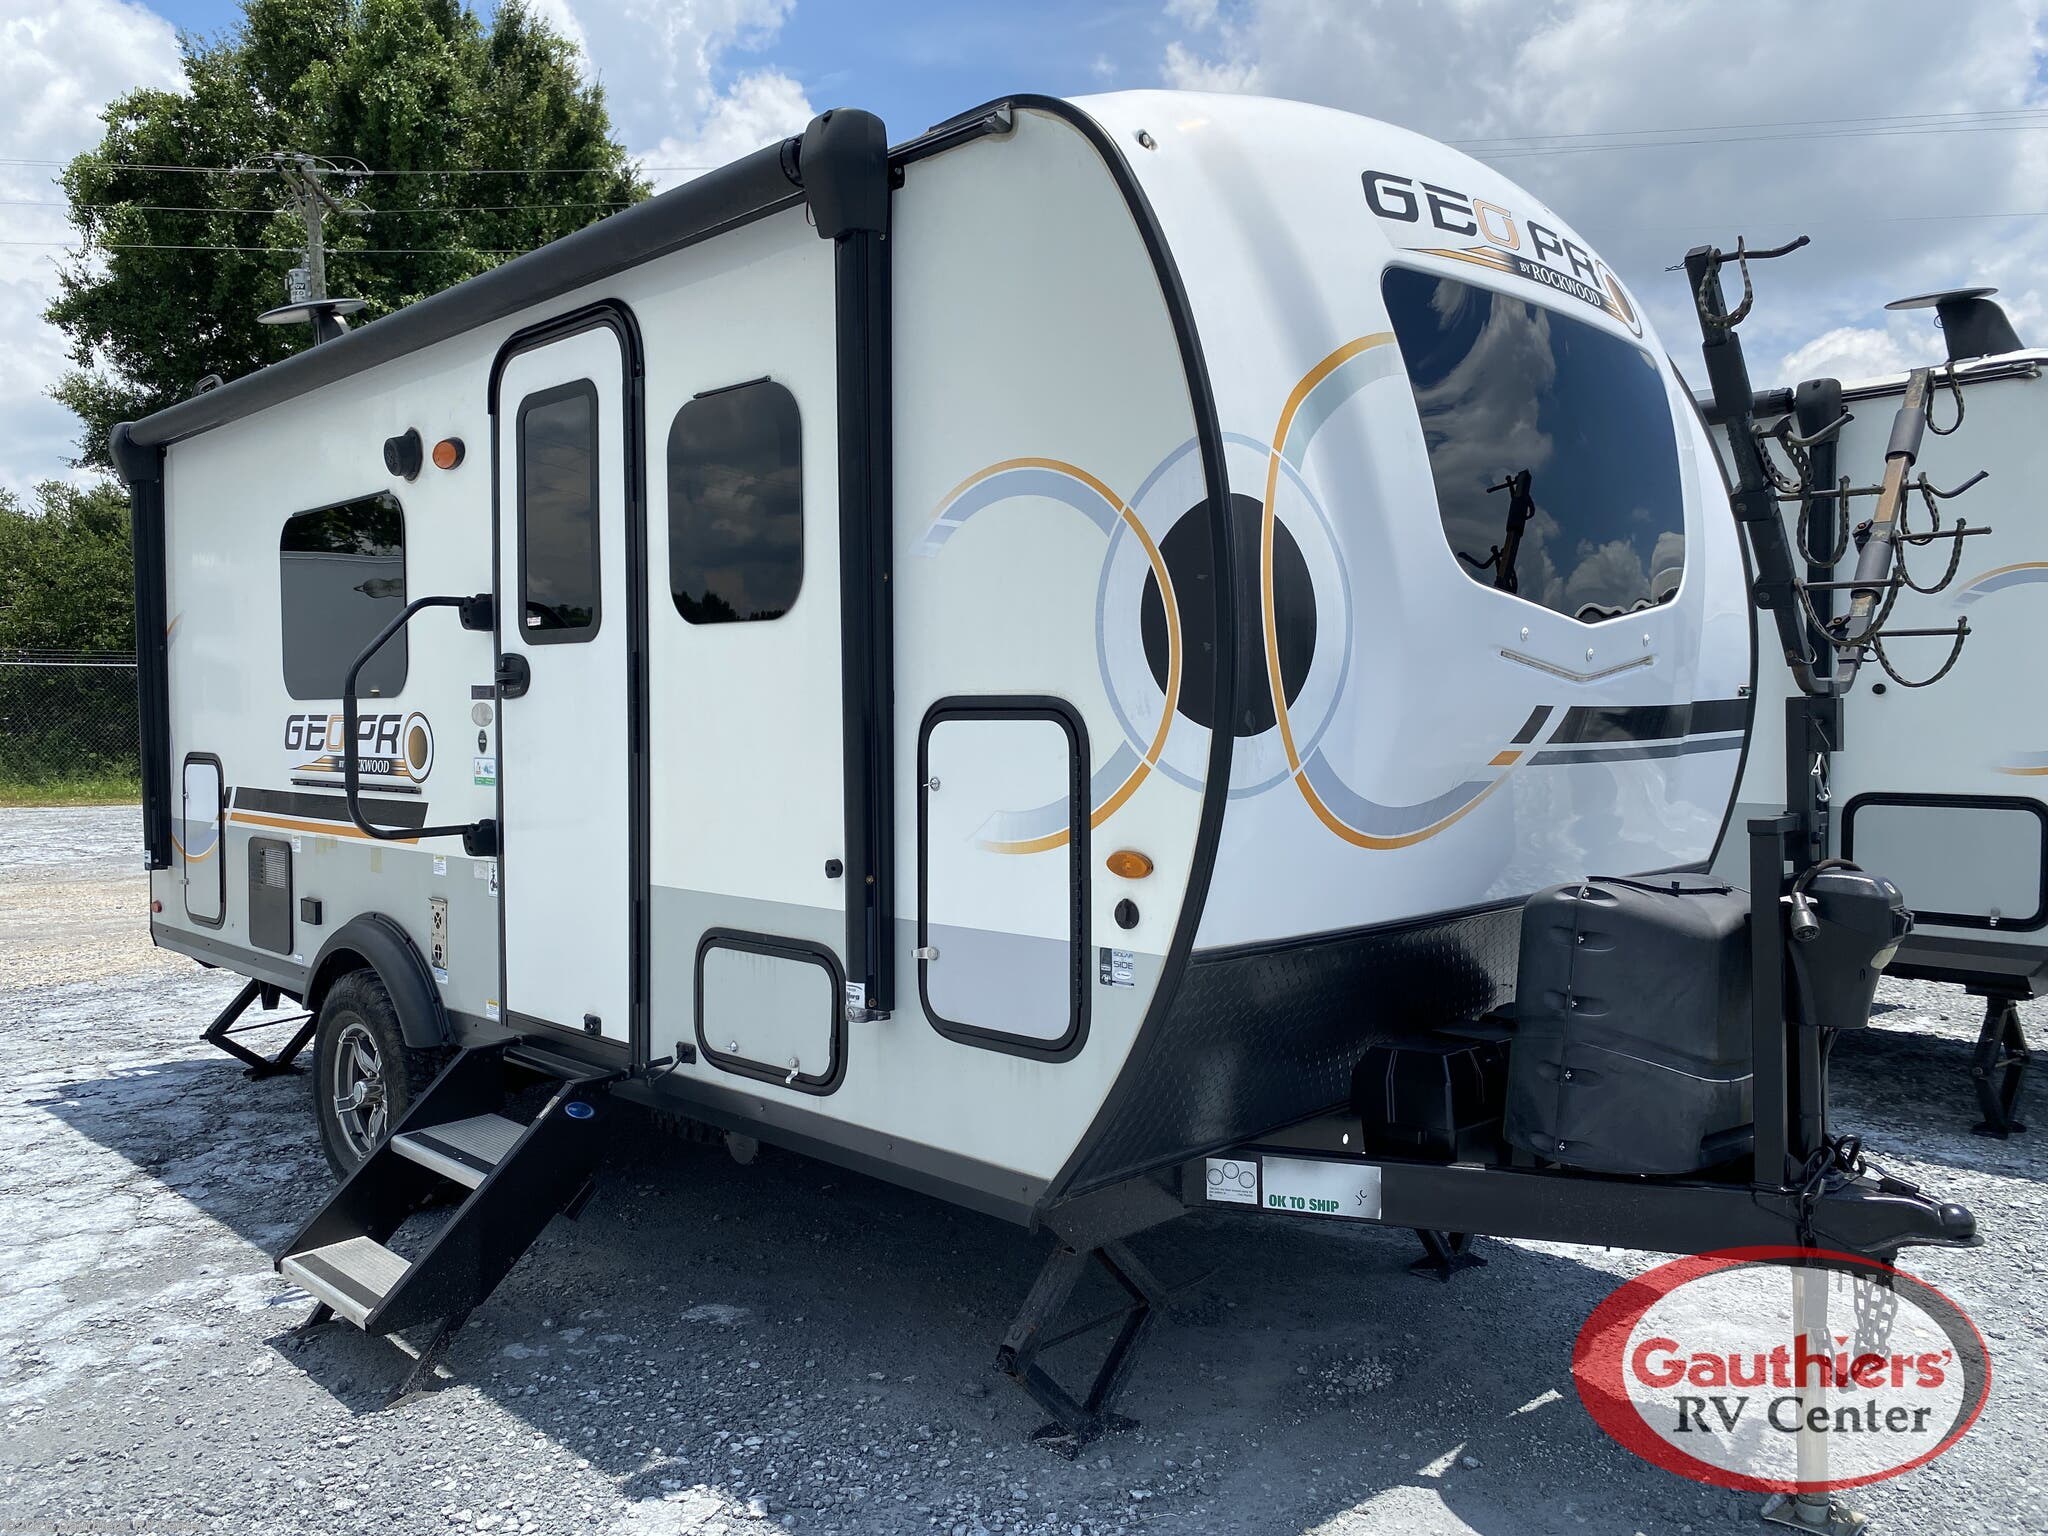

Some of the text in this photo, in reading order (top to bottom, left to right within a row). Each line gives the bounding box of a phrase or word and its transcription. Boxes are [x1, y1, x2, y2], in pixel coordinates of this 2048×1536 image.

[1361, 170, 1642, 339] GEO PRO
[1519, 261, 1601, 307] BY ROCKWOOD
[1113, 961, 1134, 970] SIDE
[1268, 1194, 1340, 1213] OK TO SHIP
